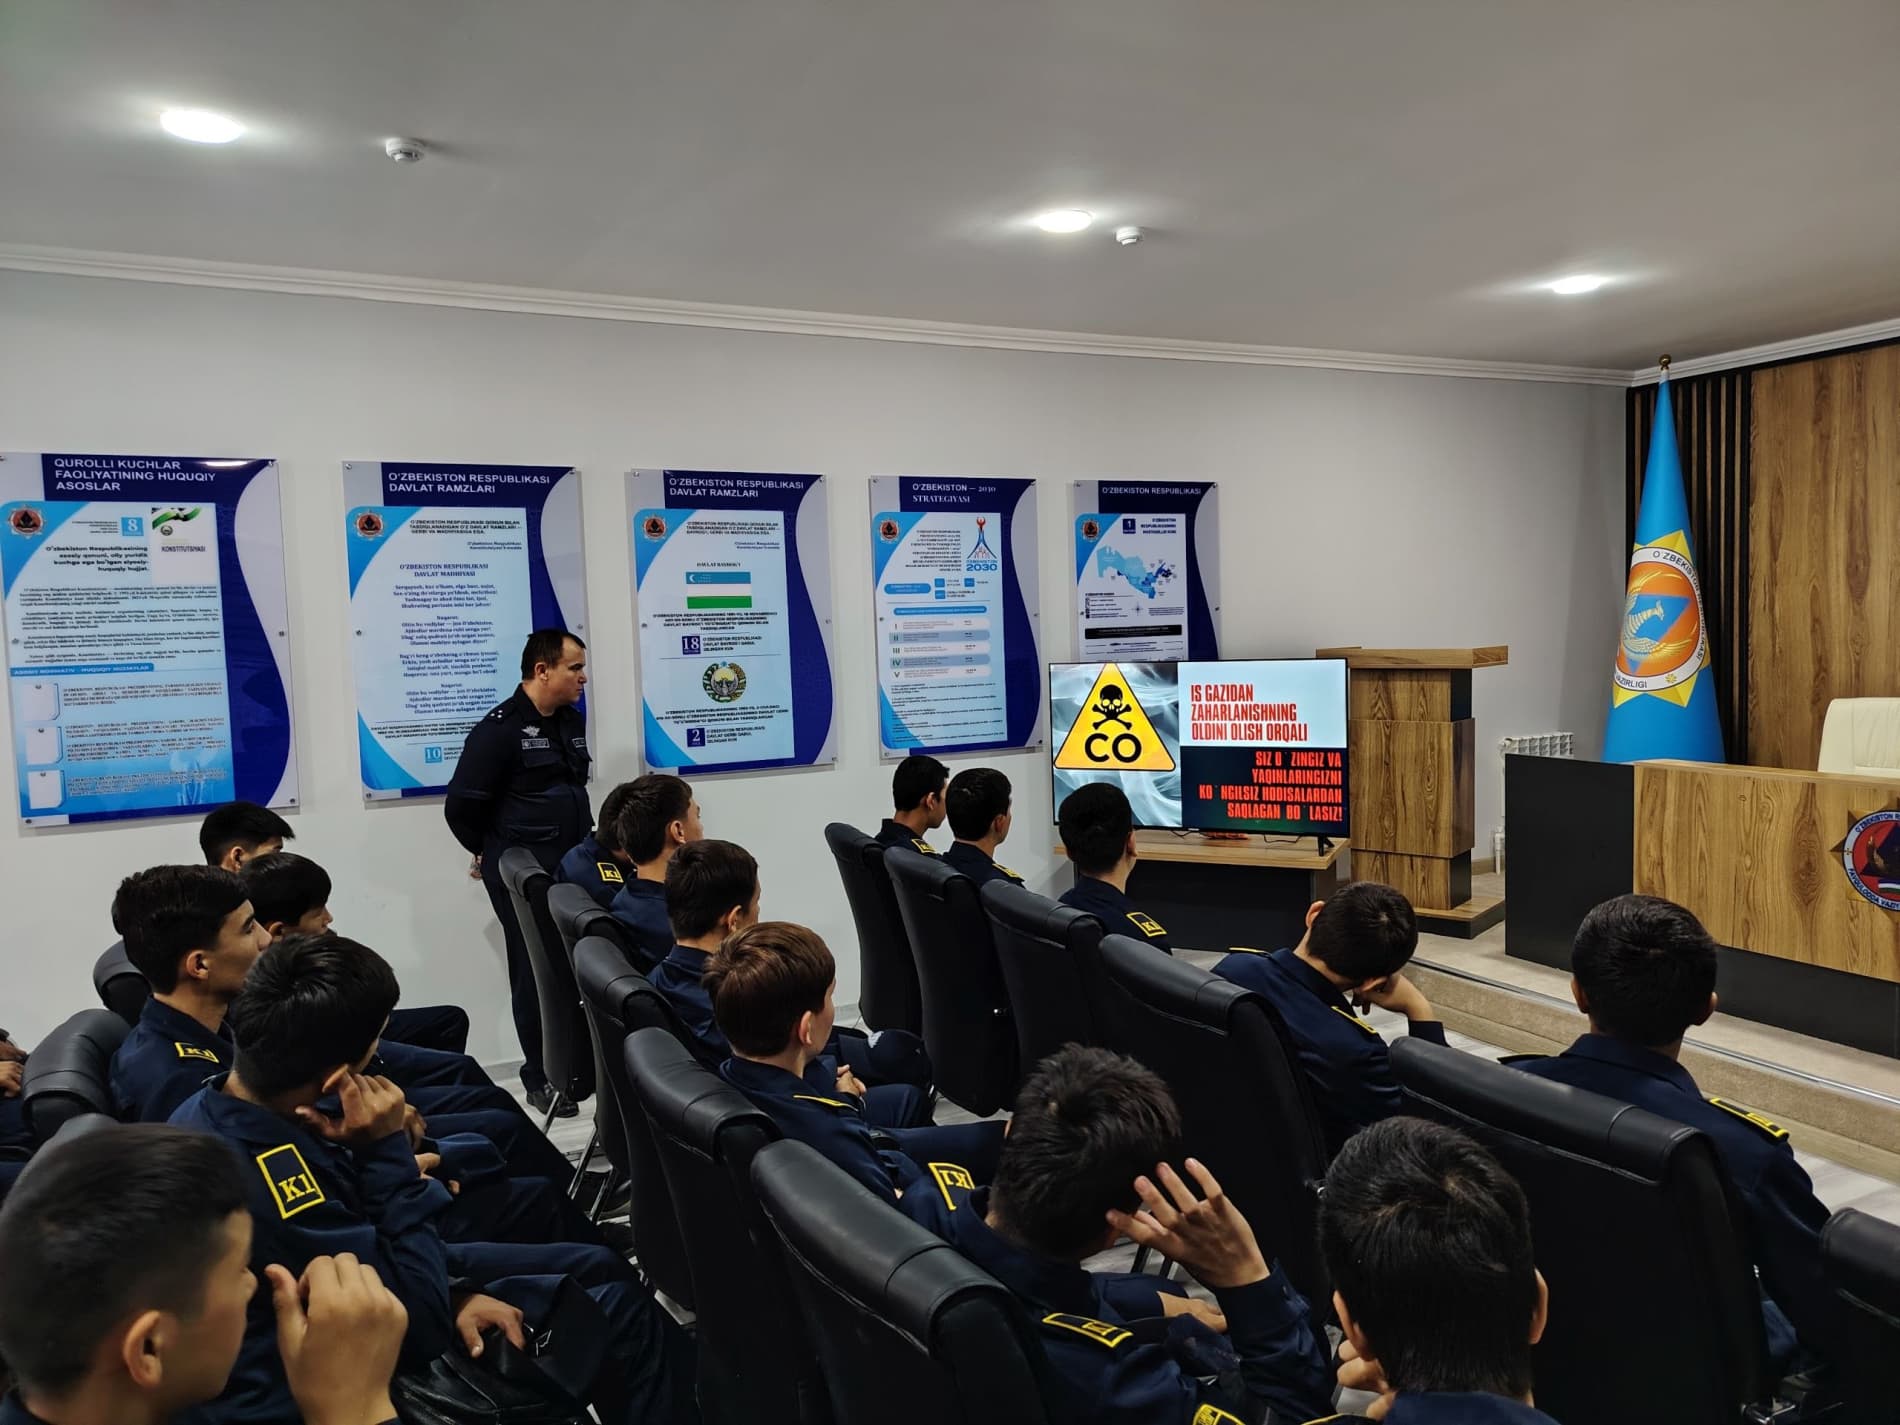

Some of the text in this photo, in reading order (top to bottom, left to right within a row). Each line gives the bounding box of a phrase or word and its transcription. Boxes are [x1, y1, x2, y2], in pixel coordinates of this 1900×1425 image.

[54, 459, 181, 469] QUROLLI KUCHLAR
[55, 470, 216, 481] FAOLIYATINING HUQUQIY
[388, 472, 550, 484] O'ZBEKISTON RESPUBLIKASI
[56, 482, 121, 491] ASOSLAR
[389, 483, 496, 493] DAVLAT RAMZLARI
[669, 478, 804, 489] O'ZBEKISTON RESPUBLIKASI
[912, 483, 967, 491] O'ZBEKISTON
[669, 488, 759, 497] DAVLAT RAMZLARI
[1151, 487, 1201, 495] RESPUBLIKASI
[912, 495, 970, 503] STRATEGIYASI
[128, 518, 138, 531] 8
[966, 563, 998, 571] 2030
[683, 637, 699, 649] 18
[1191, 684, 1254, 702] IS GAZIDAN
[1191, 704, 1297, 721] ZAHARLANISHNING
[692, 729, 700, 741] 2
[1192, 723, 1308, 742] OLDINI OLISH ORQALI
[426, 748, 441, 759] 10
[1085, 733, 1142, 763] CO
[1256, 752, 1272, 766] SIZ
[1327, 752, 1341, 767] VA
[1252, 768, 1342, 785] YAQINLARINGIZNI
[1262, 787, 1342, 803] HODISALARDAN
[1227, 803, 1281, 820] SAQLAGAN
[278, 1172, 316, 1202] K1
